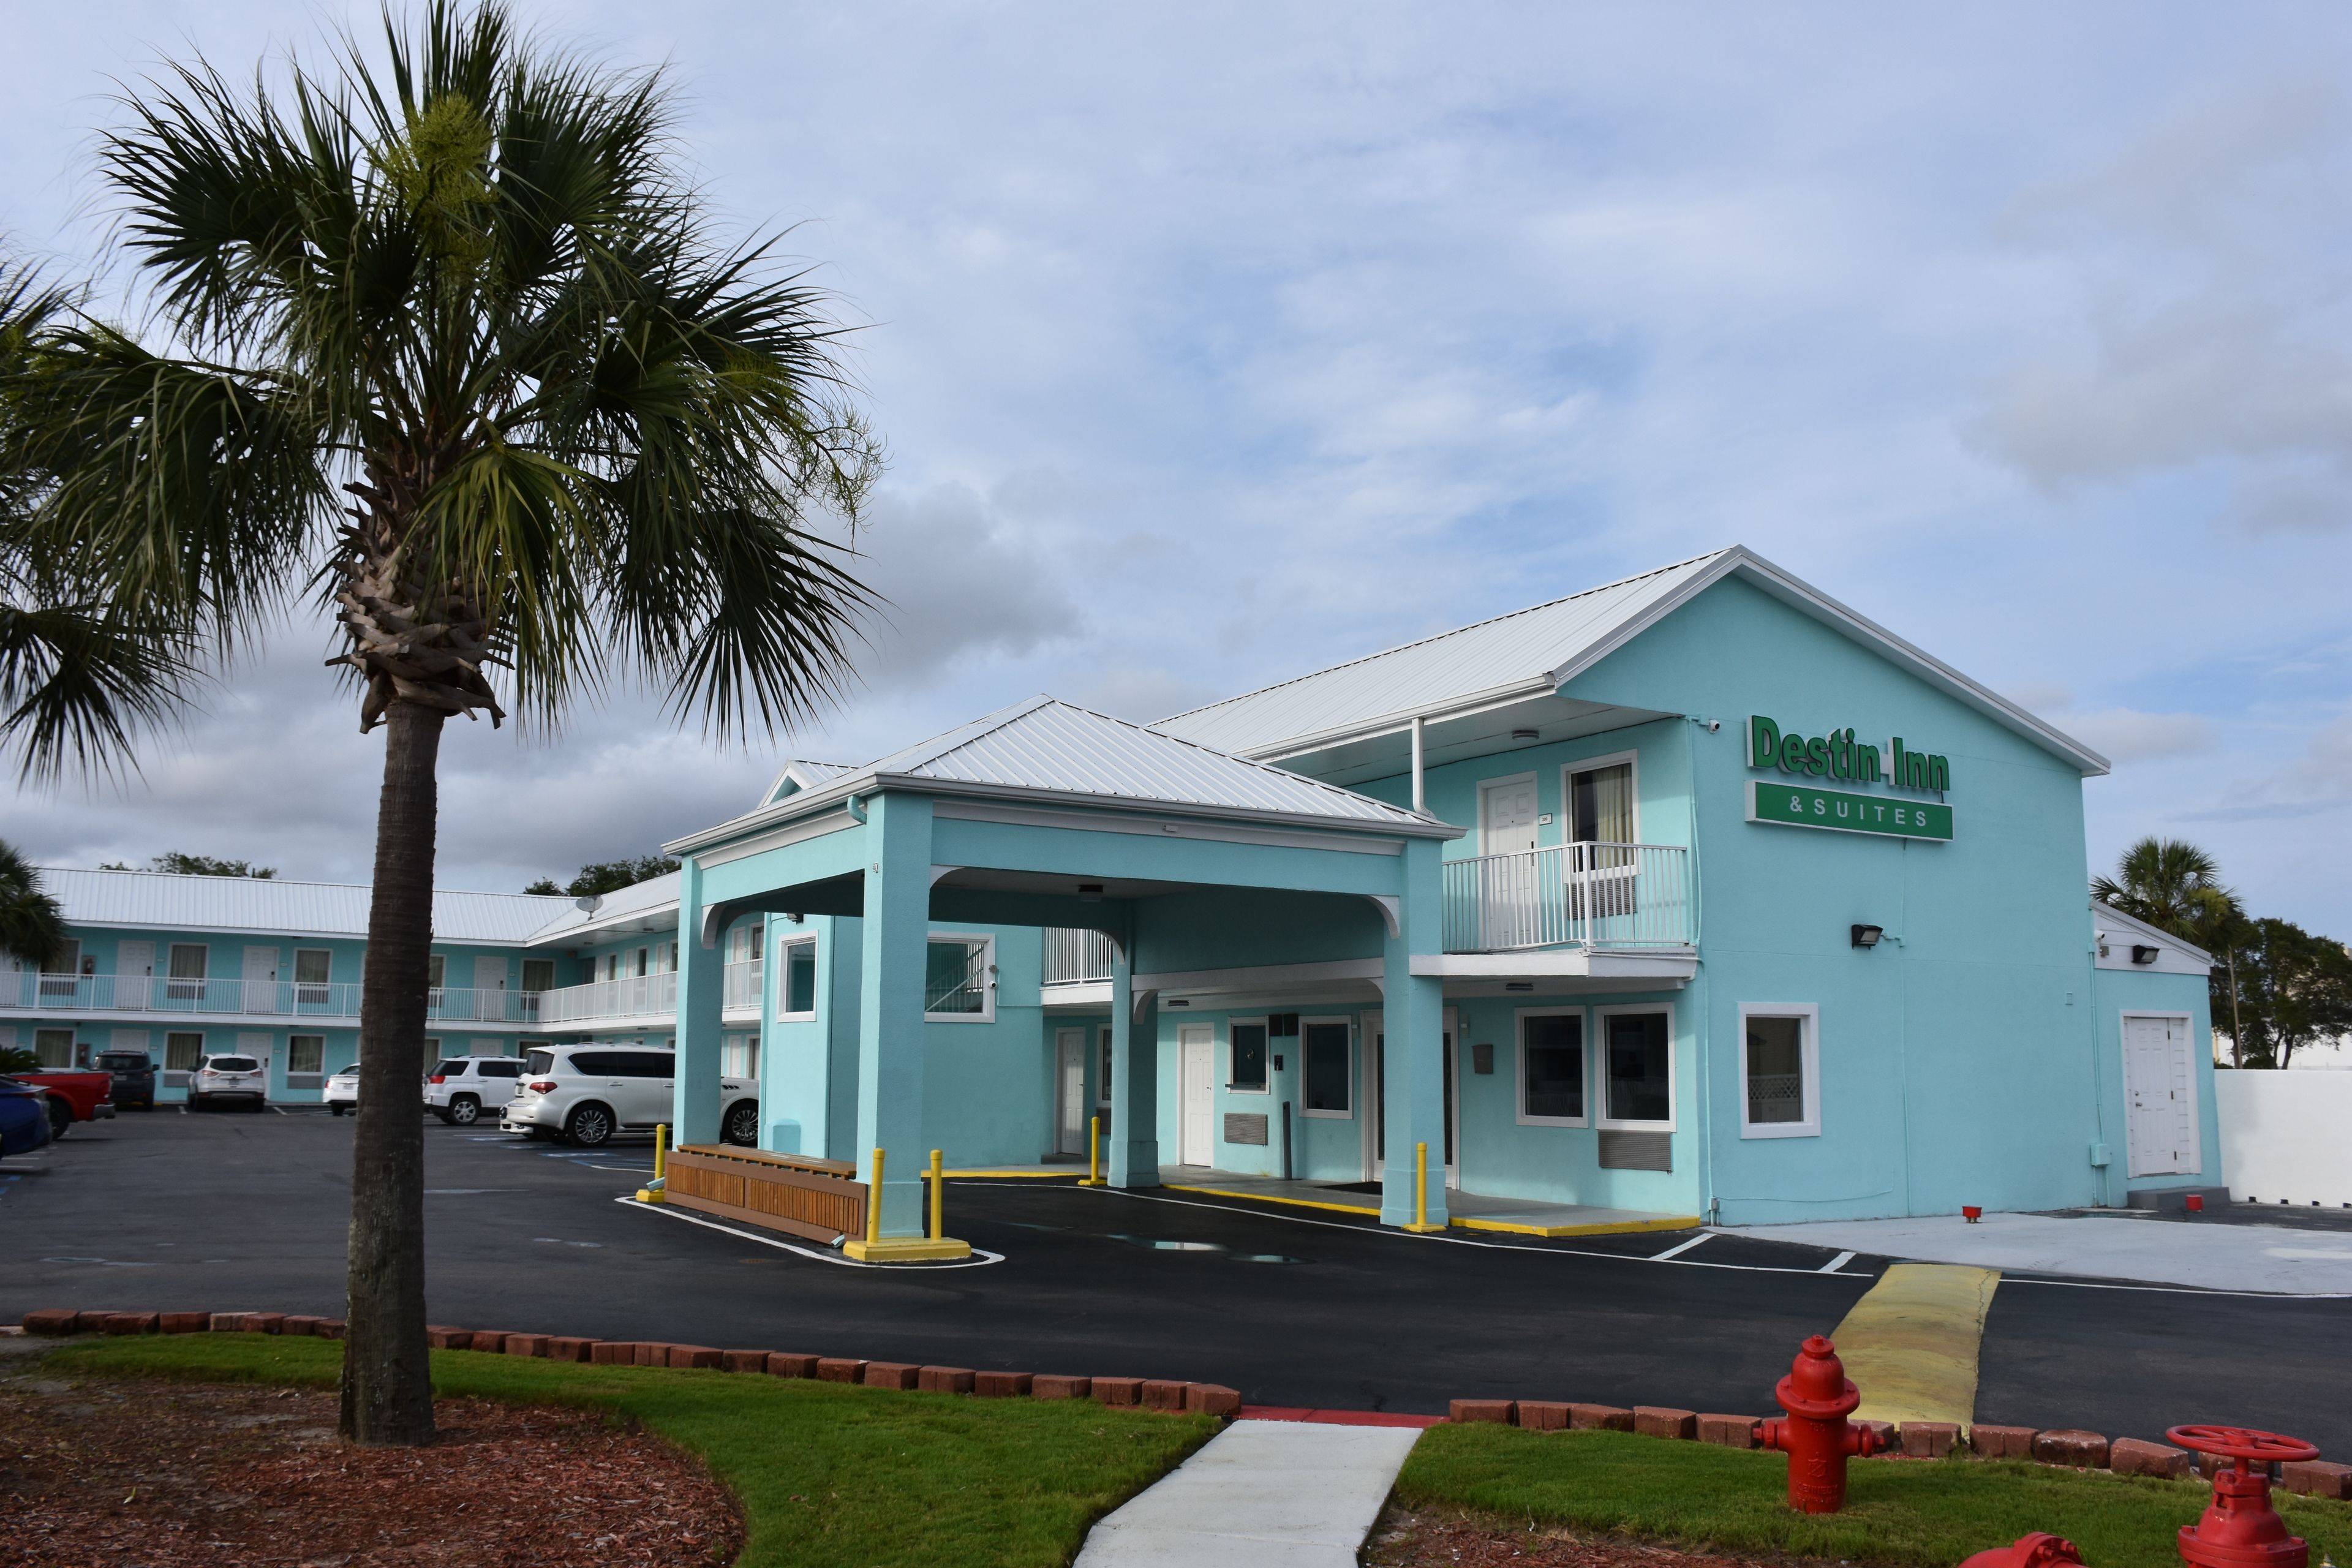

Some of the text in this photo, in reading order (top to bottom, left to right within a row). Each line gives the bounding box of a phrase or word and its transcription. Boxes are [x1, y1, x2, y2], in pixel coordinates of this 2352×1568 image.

[1749, 715, 1950, 791] Destin Inn
[1790, 796, 1927, 827] & SUITES
